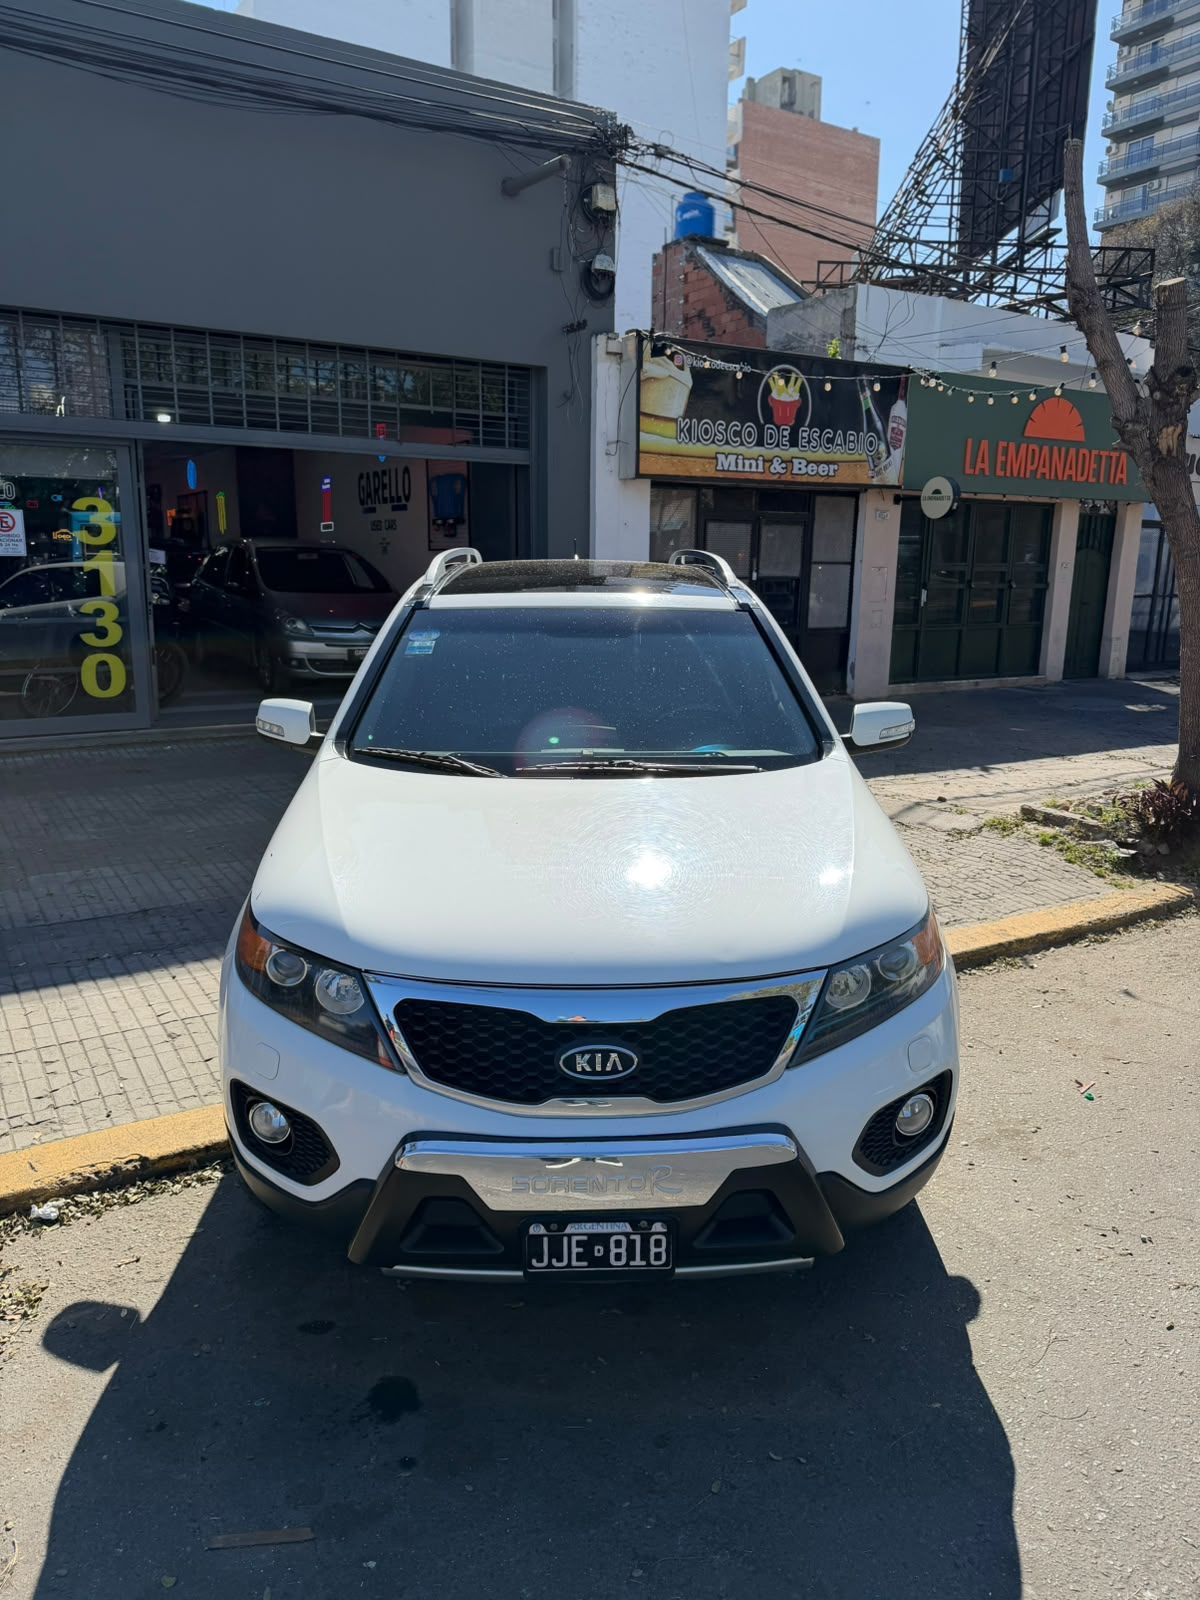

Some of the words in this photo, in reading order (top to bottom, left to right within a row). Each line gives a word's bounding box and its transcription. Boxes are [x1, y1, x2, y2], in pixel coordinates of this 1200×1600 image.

[677, 417, 758, 448] KIOSCO
[763, 423, 790, 450] DE
[799, 427, 879, 455] ESCABIO
[716, 453, 764, 474] Mini
[769, 459, 788, 475] &
[792, 458, 839, 477] Beer
[964, 437, 990, 476] LA
[996, 440, 1129, 486] EMPANADETTA
[357, 465, 411, 507] GARELLO
[575, 1052, 624, 1073] KIA
[511, 1174, 647, 1194] SORENTO
[569, 1222, 628, 1231] ARGENTINA
[531, 1235, 588, 1267] JJE
[609, 1234, 667, 1266] 818
